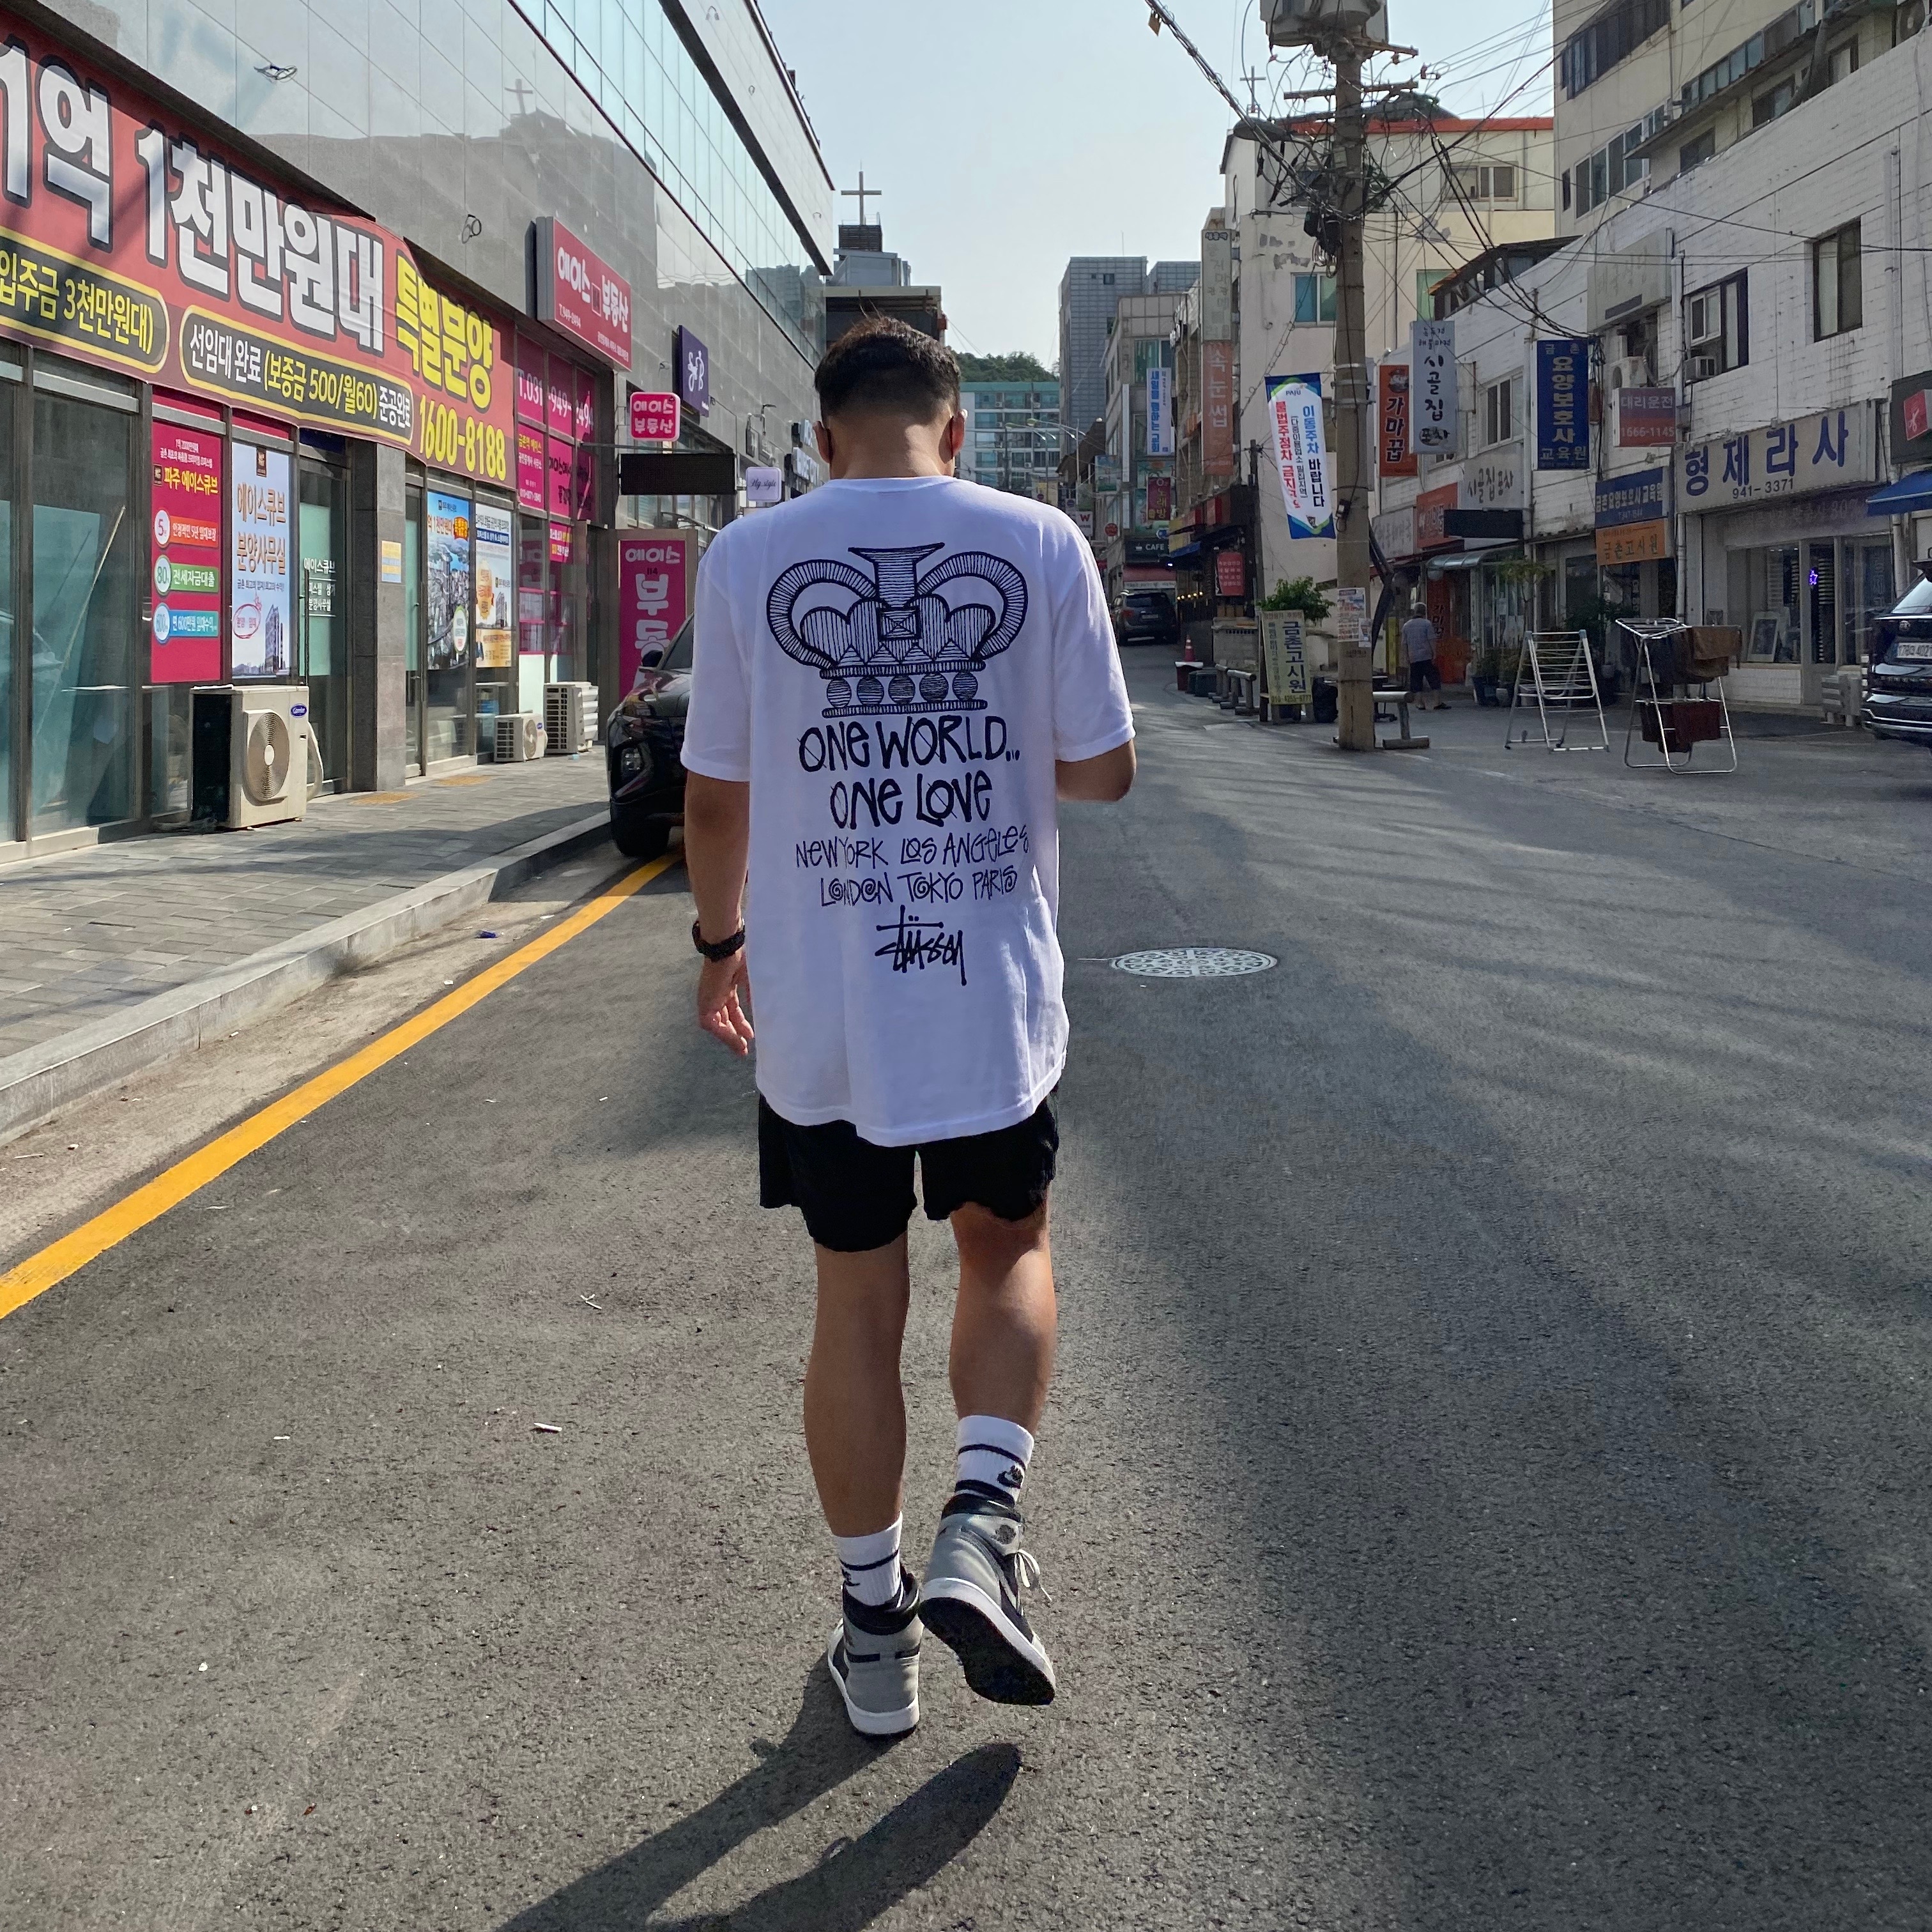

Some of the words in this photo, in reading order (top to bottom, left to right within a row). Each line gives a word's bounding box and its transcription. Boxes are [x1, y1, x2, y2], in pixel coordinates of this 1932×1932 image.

[0, 45, 111, 245] 1억
[138, 128, 383, 353] 1천만원대
[0, 254, 59, 321] 입주금
[64, 279, 153, 355] 3천만원대)
[558, 247, 590, 303] 에이스
[602, 275, 629, 333] 부동산
[396, 255, 493, 408] 특별분양
[190, 324, 232, 379] 선임대
[234, 339, 262, 383] 완료
[264, 350, 307, 402] (보증금
[309, 368, 377, 420] 500/월60)
[379, 385, 411, 429] 준공완료
[1424, 355, 1444, 422] 시골집
[633, 399, 673, 414] 에이스
[1552, 356, 1575, 443] 요양보호사
[1621, 395, 1673, 410] 대리운전
[420, 394, 506, 481] 1600-8188
[634, 418, 673, 434] 부동산
[1303, 405, 1319, 454] 이동주차
[1540, 446, 1586, 461] 교육원
[1685, 411, 1848, 497] 형제라사
[164, 467, 181, 490] 파주
[181, 470, 218, 496] 에이스큐브
[1308, 459, 1325, 507] 바랍니다
[1468, 466, 1496, 504] 시골집
[1732, 478, 1793, 499] 941-3371
[237, 482, 286, 526] 에이스큐브
[237, 532, 286, 575] 분양사무실
[625, 546, 680, 564] 에이스
[173, 569, 215, 587] 전세자금대출
[1282, 621, 1307, 693] 금촌고시원
[900, 837, 937, 864] LOS
[820, 871, 894, 907] LONDON
[897, 871, 963, 904] TOKYO
[972, 864, 1017, 900] PARIS
